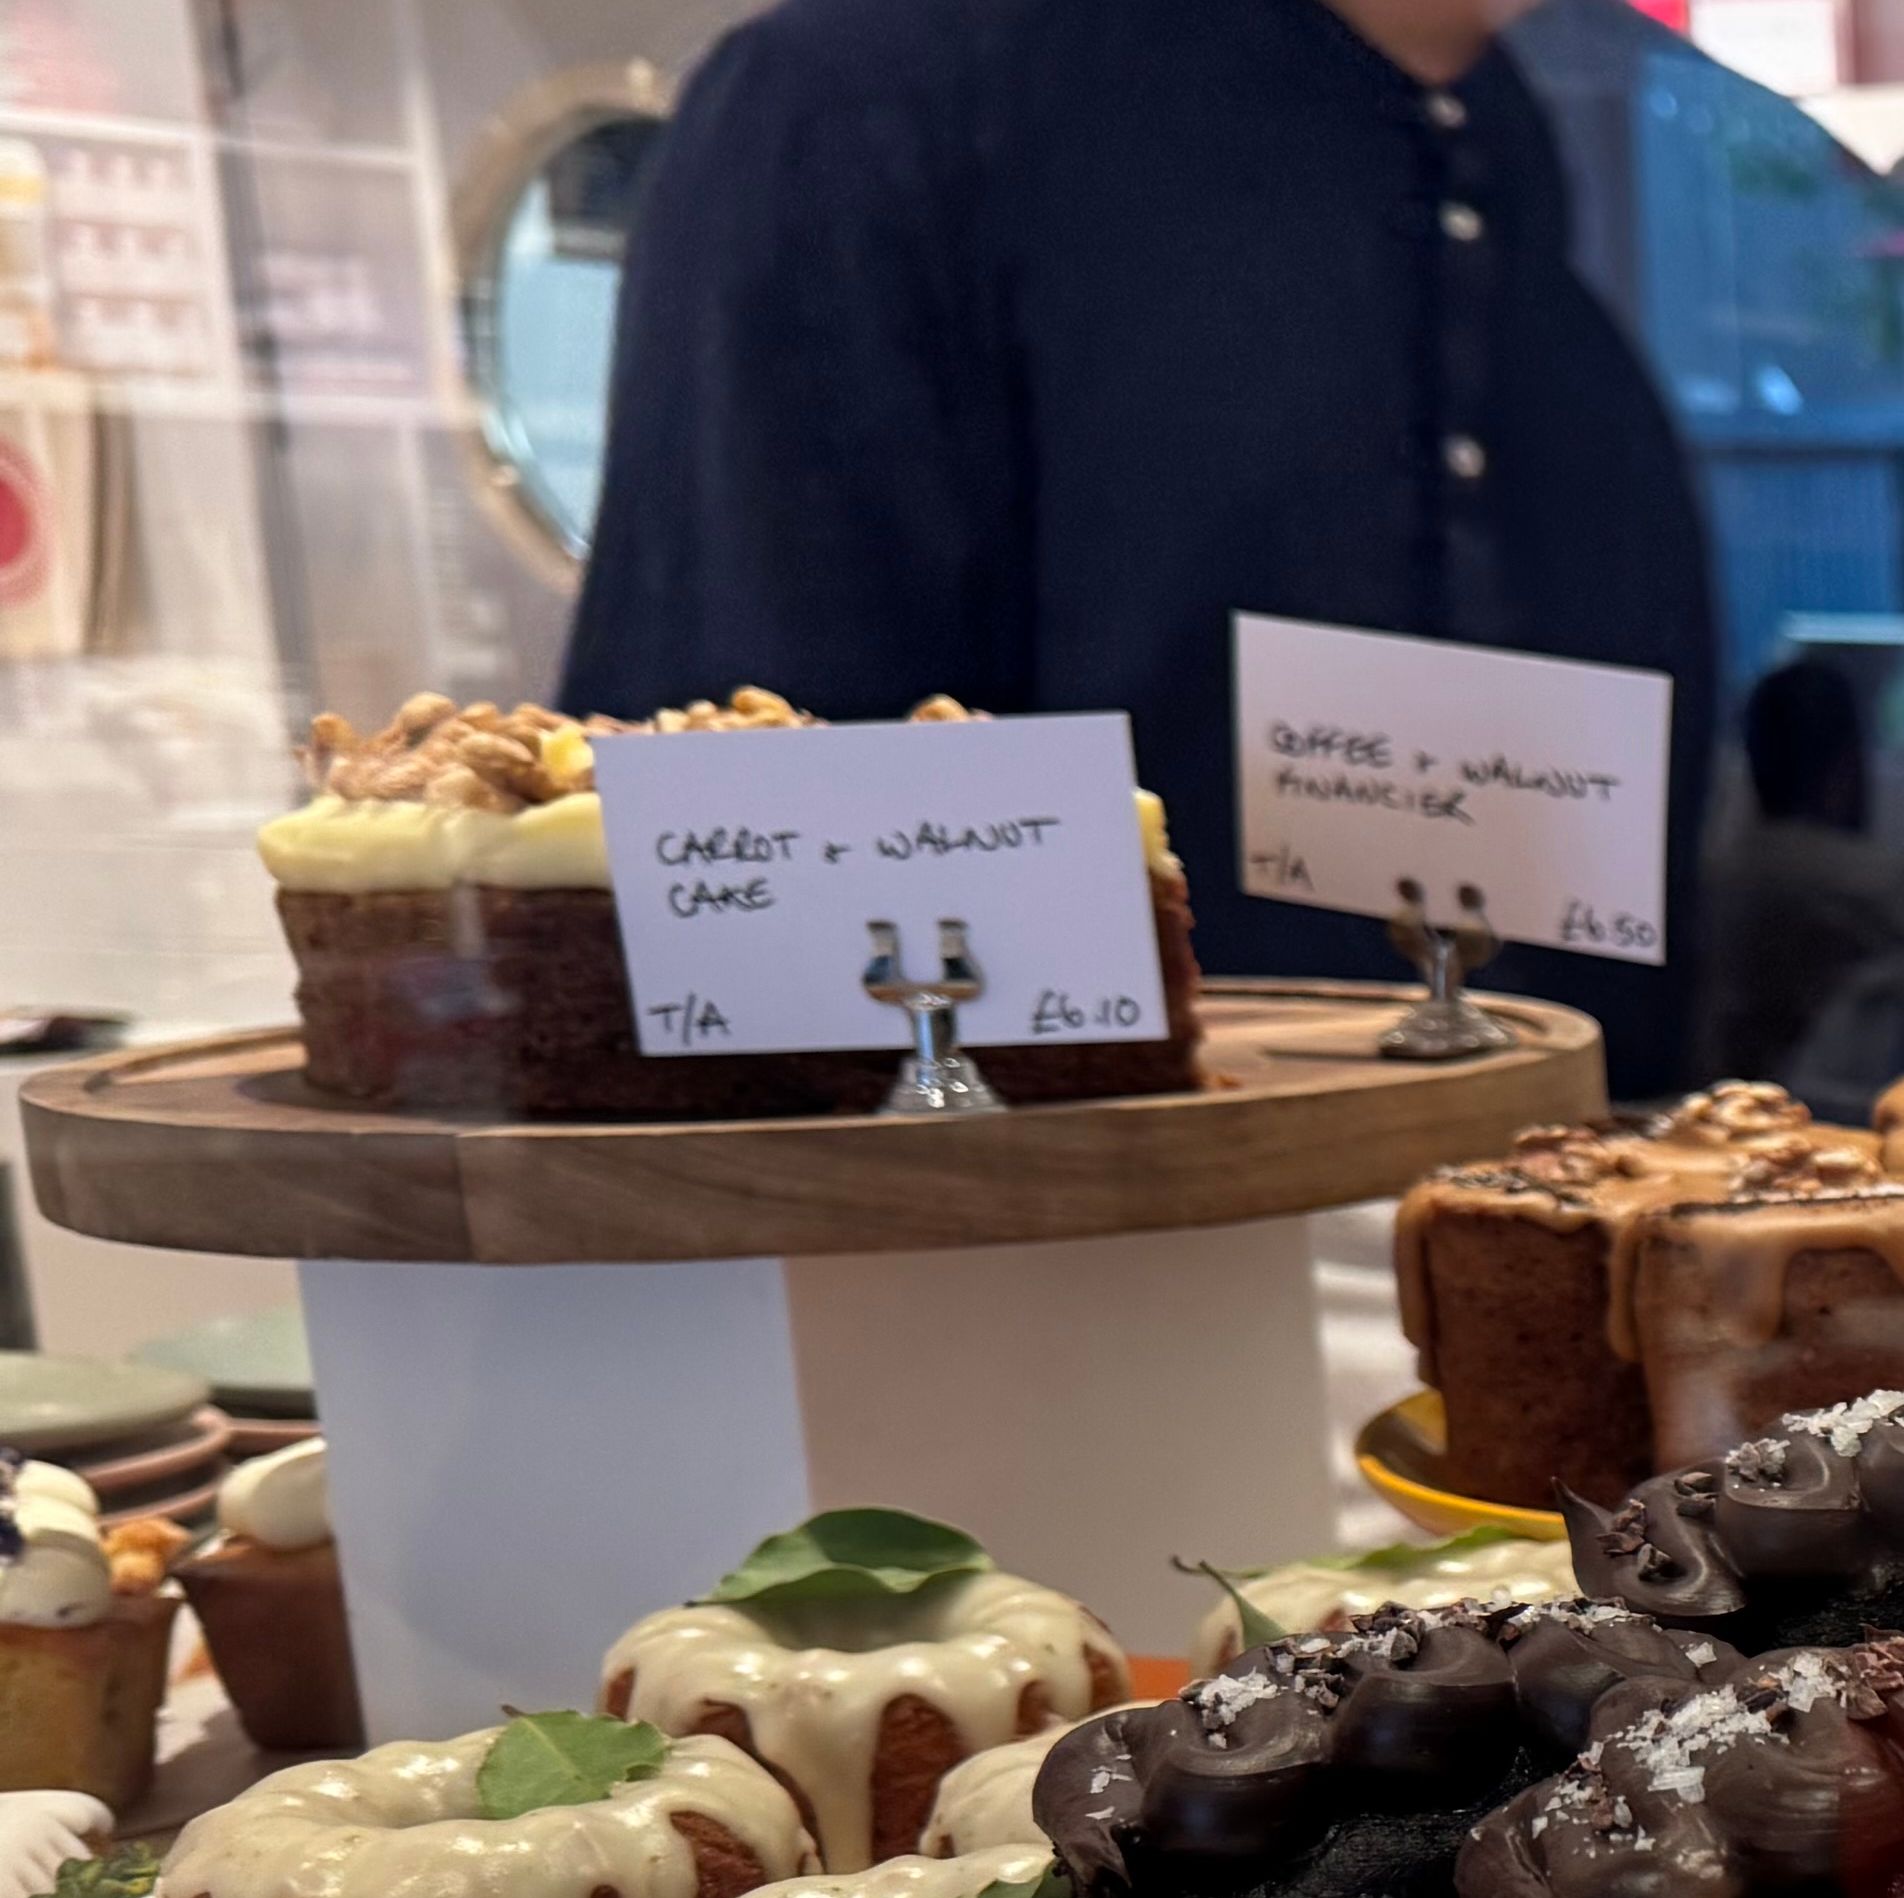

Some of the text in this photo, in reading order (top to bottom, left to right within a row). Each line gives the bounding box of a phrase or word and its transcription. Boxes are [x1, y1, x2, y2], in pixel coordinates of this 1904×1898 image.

[1266, 720, 1394, 770] COFFEE
[1459, 753, 1622, 803] WALNUT
[655, 826, 801, 867] CARROT
[875, 817, 1062, 861] WALNUT
[1250, 846, 1314, 891] T/A
[668, 876, 776, 919] CAKE
[647, 992, 731, 1047] T/A
